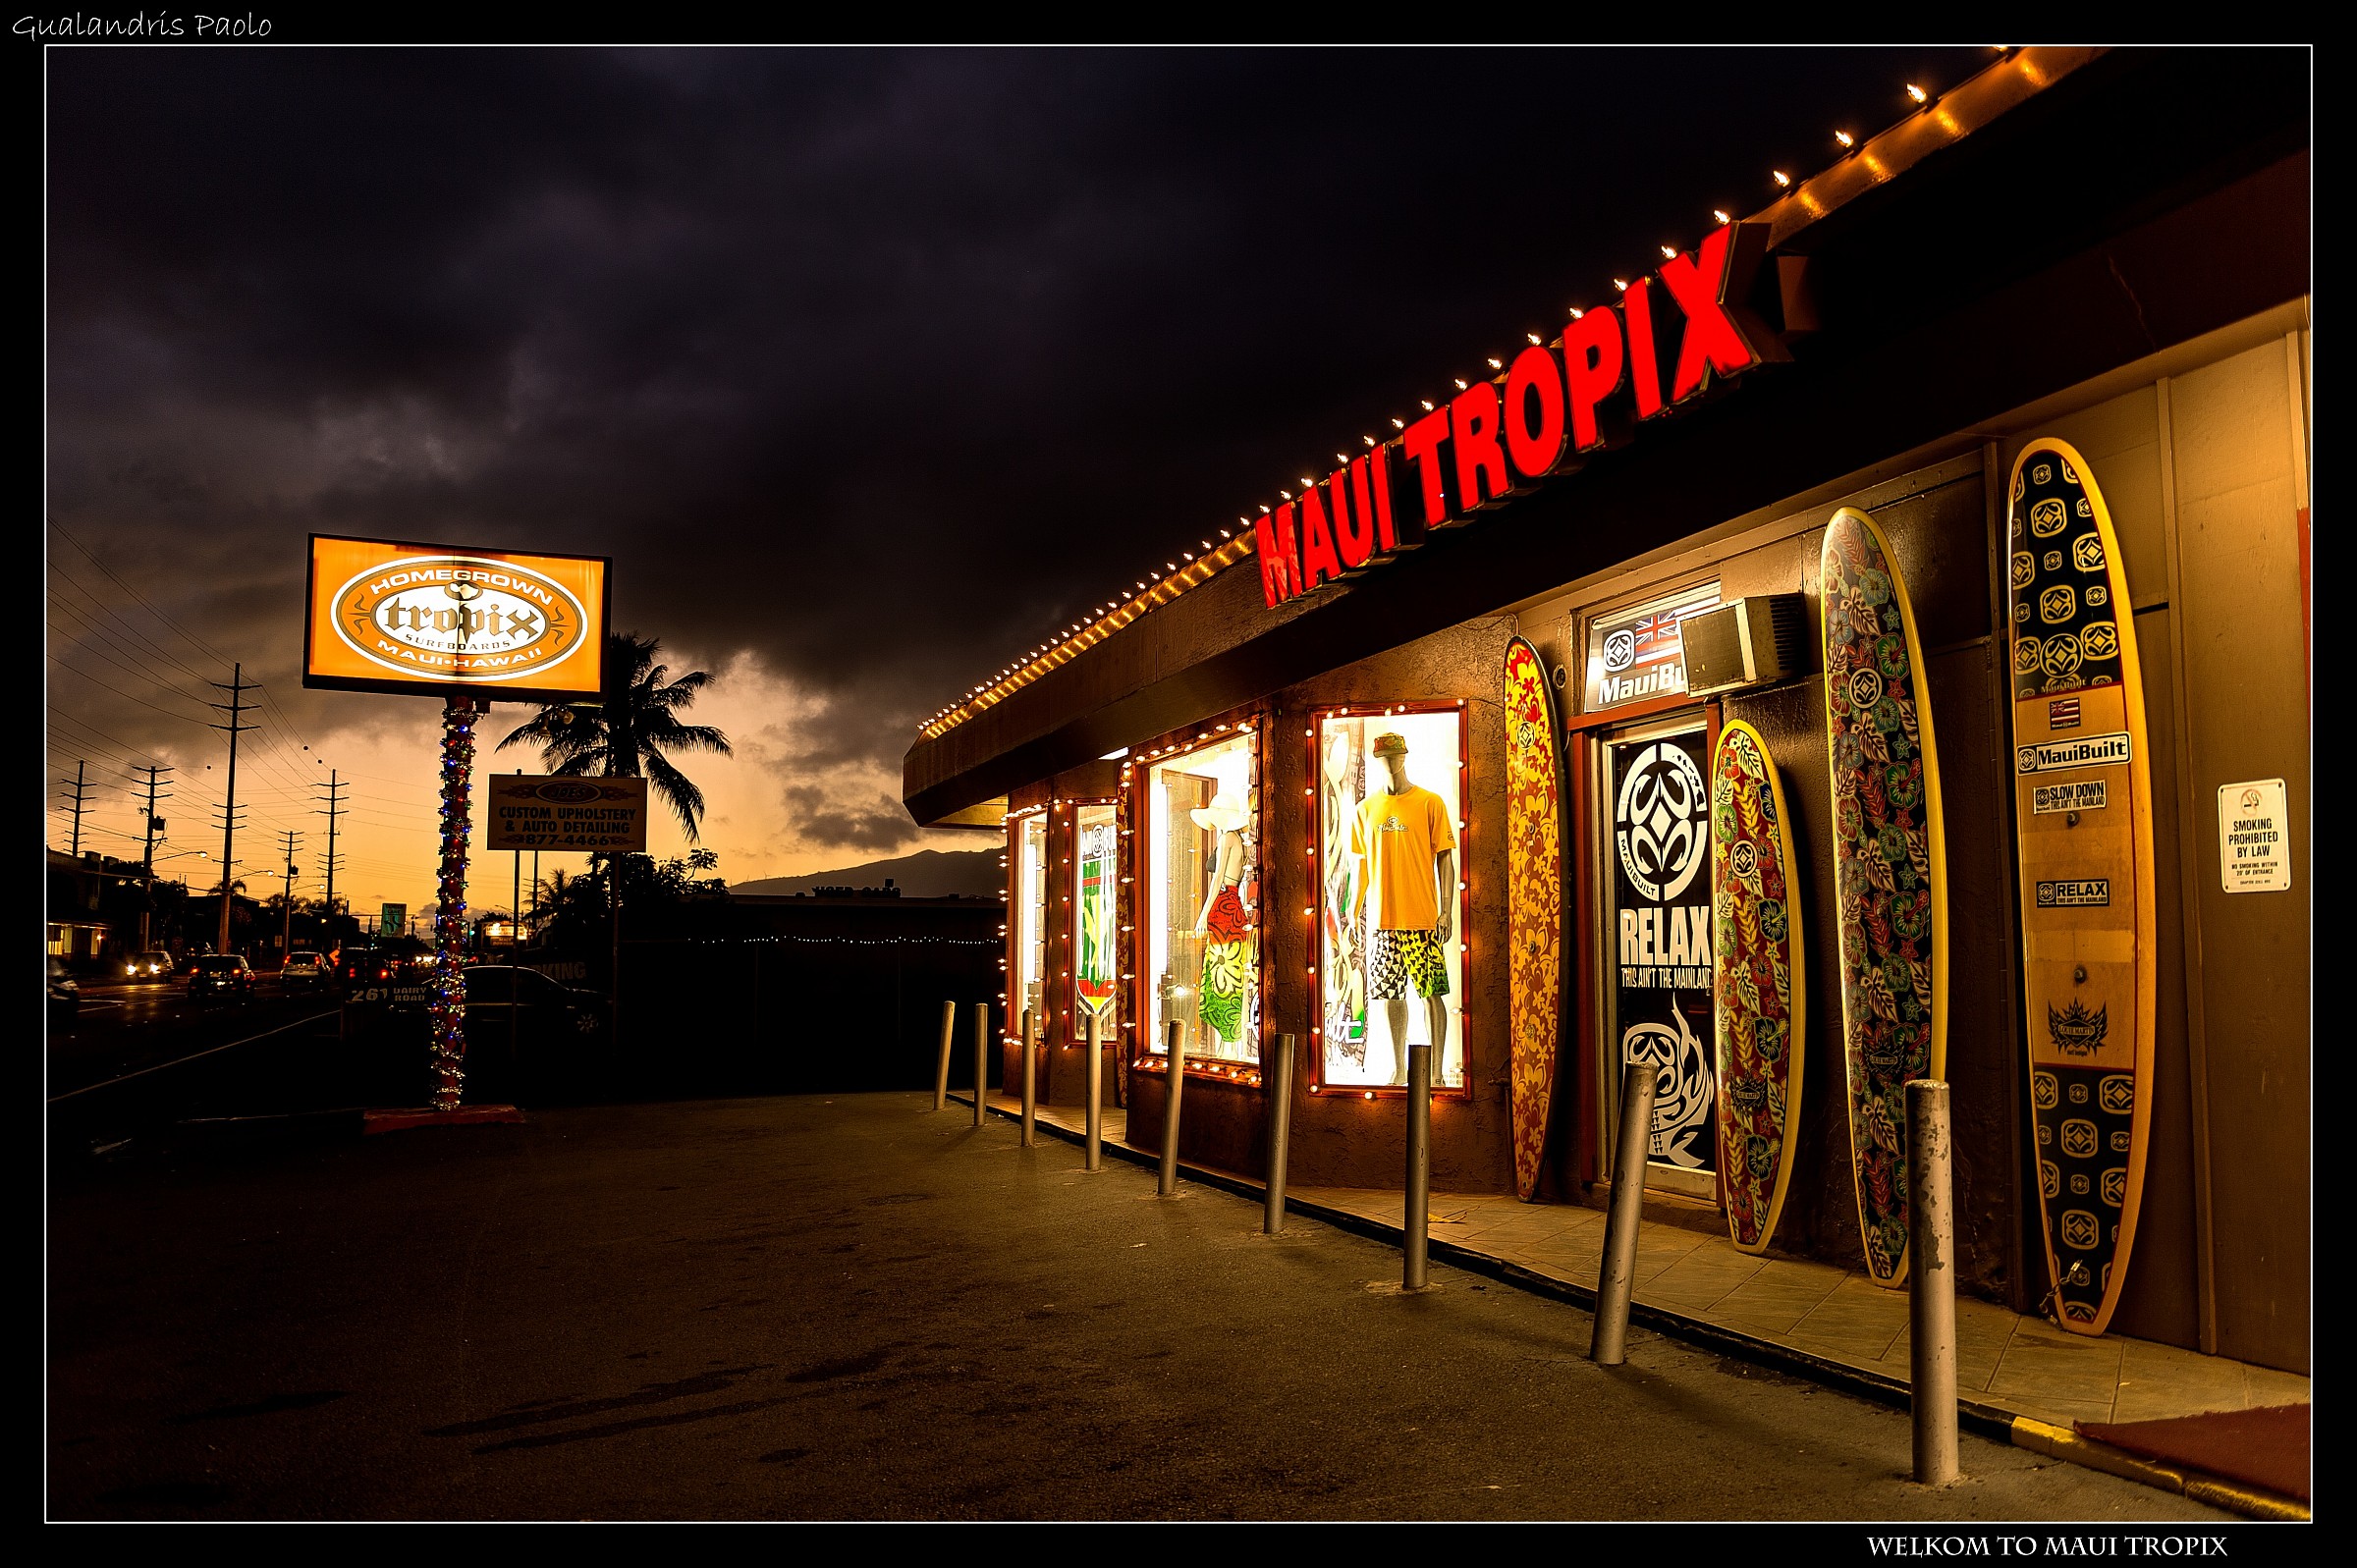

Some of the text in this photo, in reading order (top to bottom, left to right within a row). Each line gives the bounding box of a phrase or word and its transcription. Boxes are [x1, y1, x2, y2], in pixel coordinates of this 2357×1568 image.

[1255, 221, 1761, 610] MAUI TROPIX
[370, 568, 553, 607] HOMEGROWN
[384, 597, 539, 644] tropix
[406, 633, 511, 651] SURFBOARDS
[1597, 662, 1685, 705] MauiBu
[2038, 740, 2127, 766] MauiBuilt
[2050, 782, 2104, 800] SLOW DOWN
[2051, 800, 2060, 810] THIS
[2082, 796, 2105, 807] MAINLAND
[499, 806, 636, 821] CUSTOM UPHOLSTERY
[505, 820, 630, 834] & AUTO DETAILING
[2233, 818, 2272, 832] SMOKING
[525, 835, 610, 846] 877-4466
[2228, 831, 2278, 845] PROHIBITED
[2237, 845, 2270, 858] BY LAW
[1620, 838, 1655, 895] MAUIBUILT
[2056, 883, 2106, 896] RELAX
[1619, 905, 1712, 966] RELAX
[1620, 967, 1637, 988] THIS
[1638, 967, 1656, 988] AIN'T
[1659, 967, 1672, 989] THE
